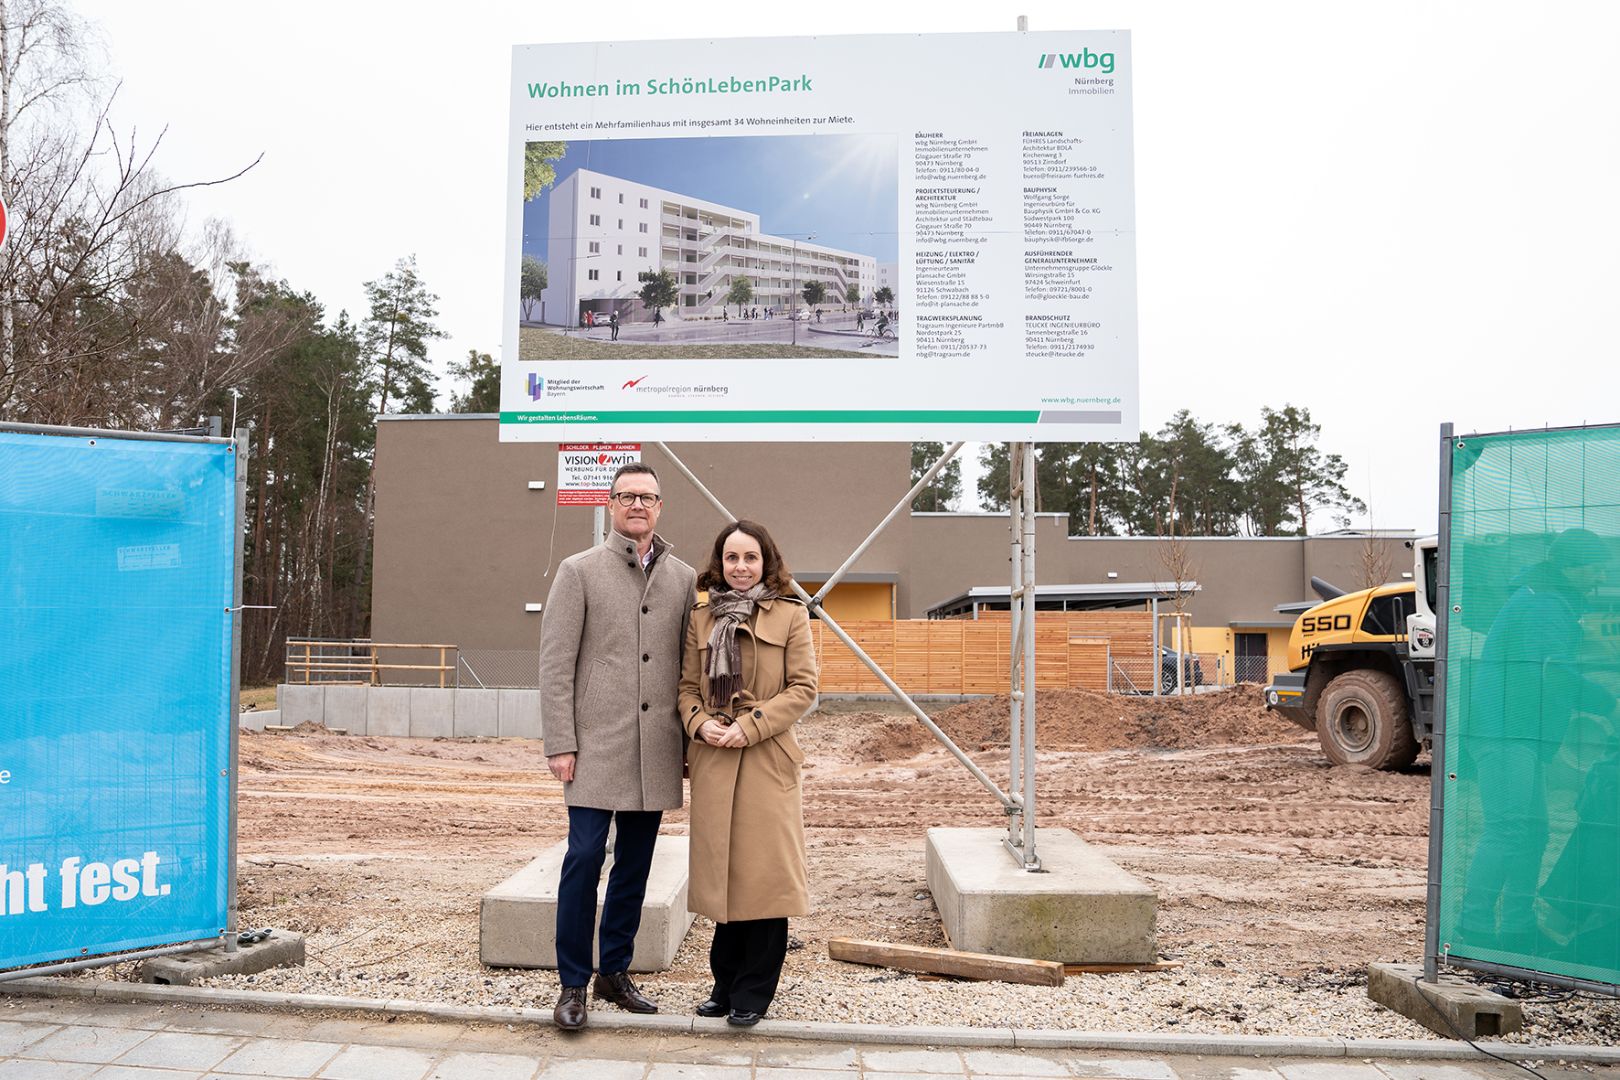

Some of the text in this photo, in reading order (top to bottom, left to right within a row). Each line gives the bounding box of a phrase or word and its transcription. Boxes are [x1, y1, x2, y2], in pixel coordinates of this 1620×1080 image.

[1059, 47, 1114, 74] wbg
[528, 75, 812, 98] Wohnen im SchönLebenPark
[1075, 78, 1114, 86] Nürnberg
[689, 119, 732, 128] insgesamt
[694, 385, 728, 394] nürnberg
[1302, 614, 1351, 633] 550
[60, 851, 171, 909] fest.
